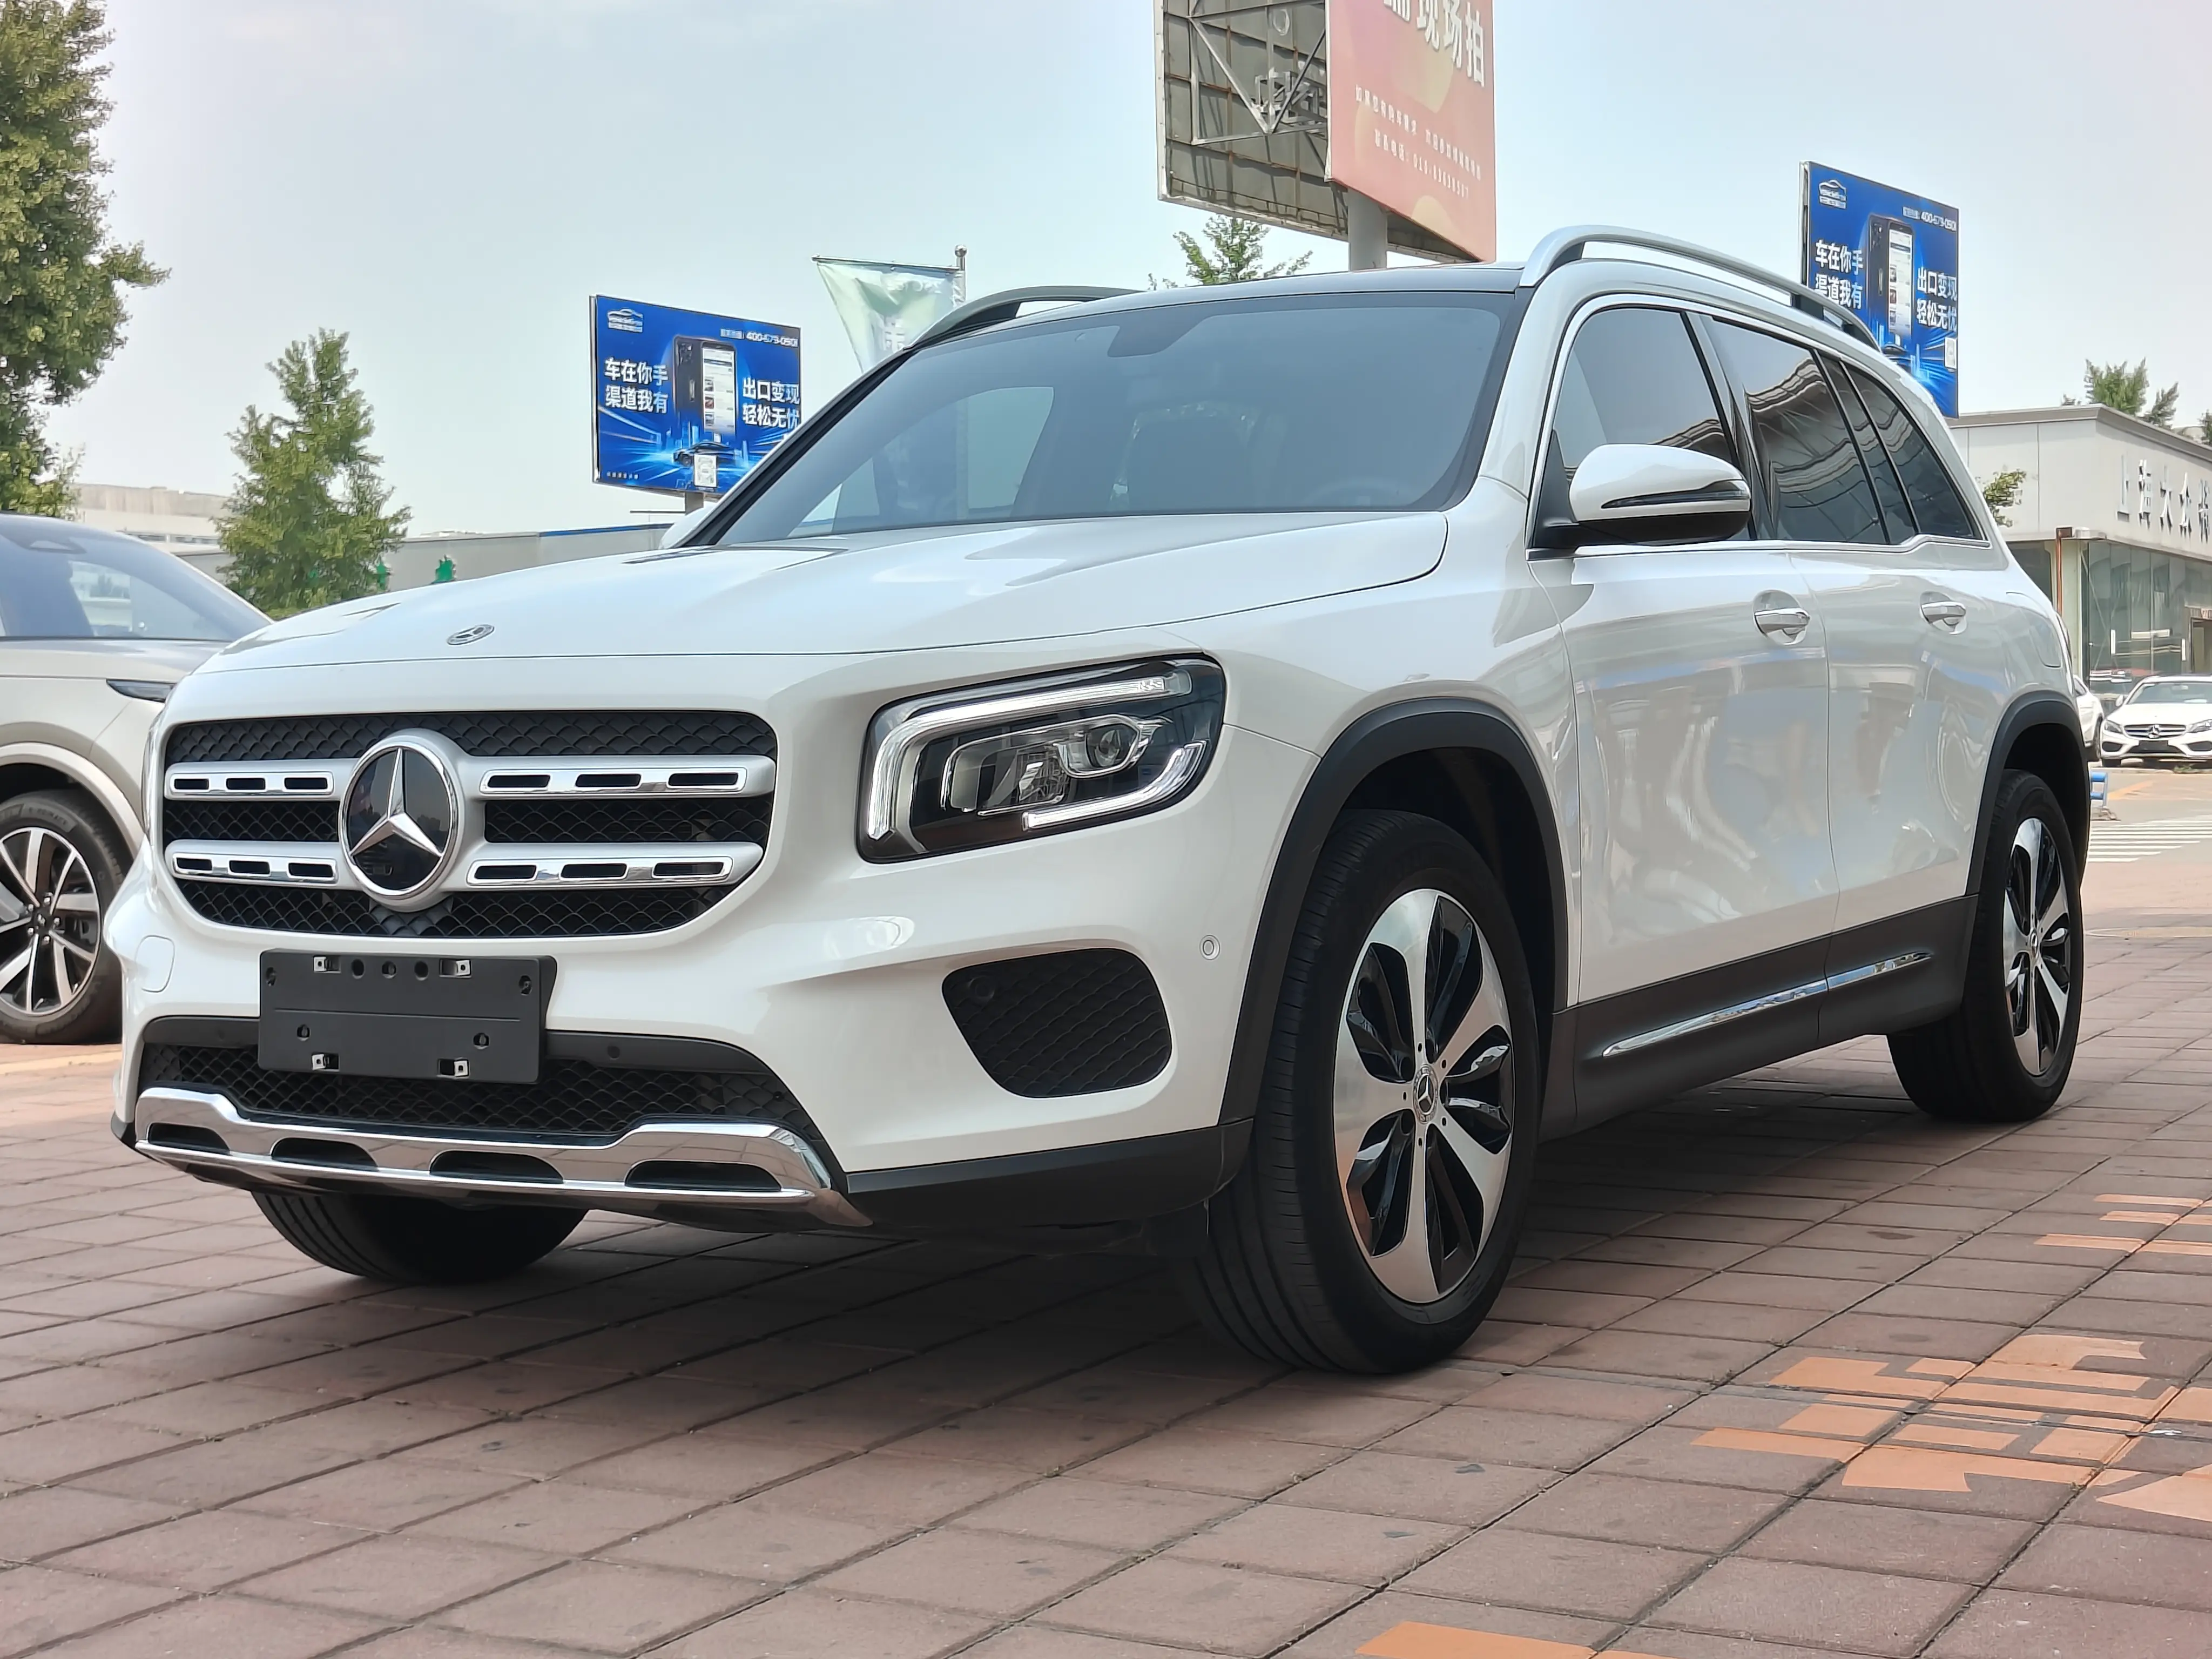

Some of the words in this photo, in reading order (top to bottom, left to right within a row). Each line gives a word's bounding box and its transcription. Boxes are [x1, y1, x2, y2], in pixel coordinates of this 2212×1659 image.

[1815, 240, 1864, 275] 车在你手
[1815, 274, 1862, 309] 渠道我有
[1917, 267, 1957, 301] 出口变现
[1917, 298, 1957, 332] 轻松无忧
[604, 357, 669, 386] 车在你手
[605, 385, 668, 414] 渠道我有
[743, 377, 800, 404] 出口变现
[743, 403, 800, 429] 轻松无忧
